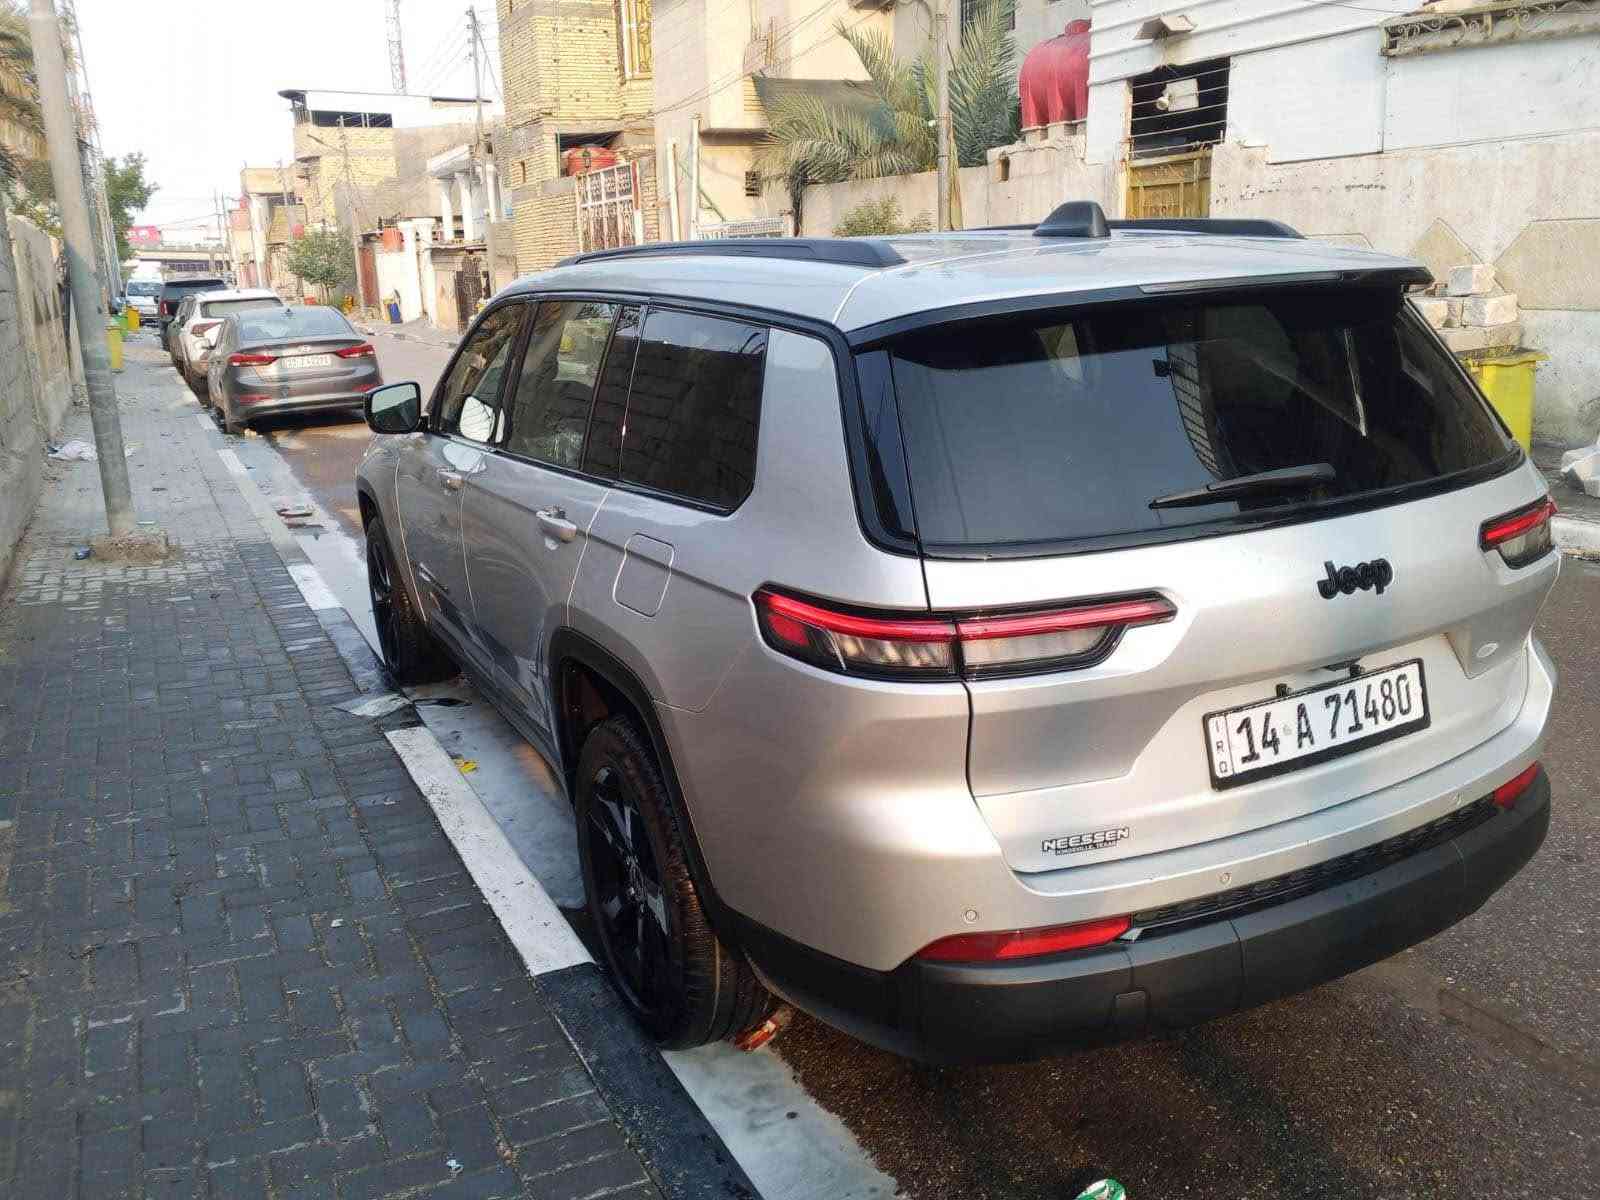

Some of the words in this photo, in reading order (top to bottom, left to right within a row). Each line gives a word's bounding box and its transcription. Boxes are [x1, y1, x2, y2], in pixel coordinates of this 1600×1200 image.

[1316, 558, 1394, 600] Jeep
[1236, 711, 1280, 764] 14
[1297, 702, 1315, 749] A
[1325, 673, 1412, 739] 71480
[1041, 826, 1130, 853] NEESSEN
